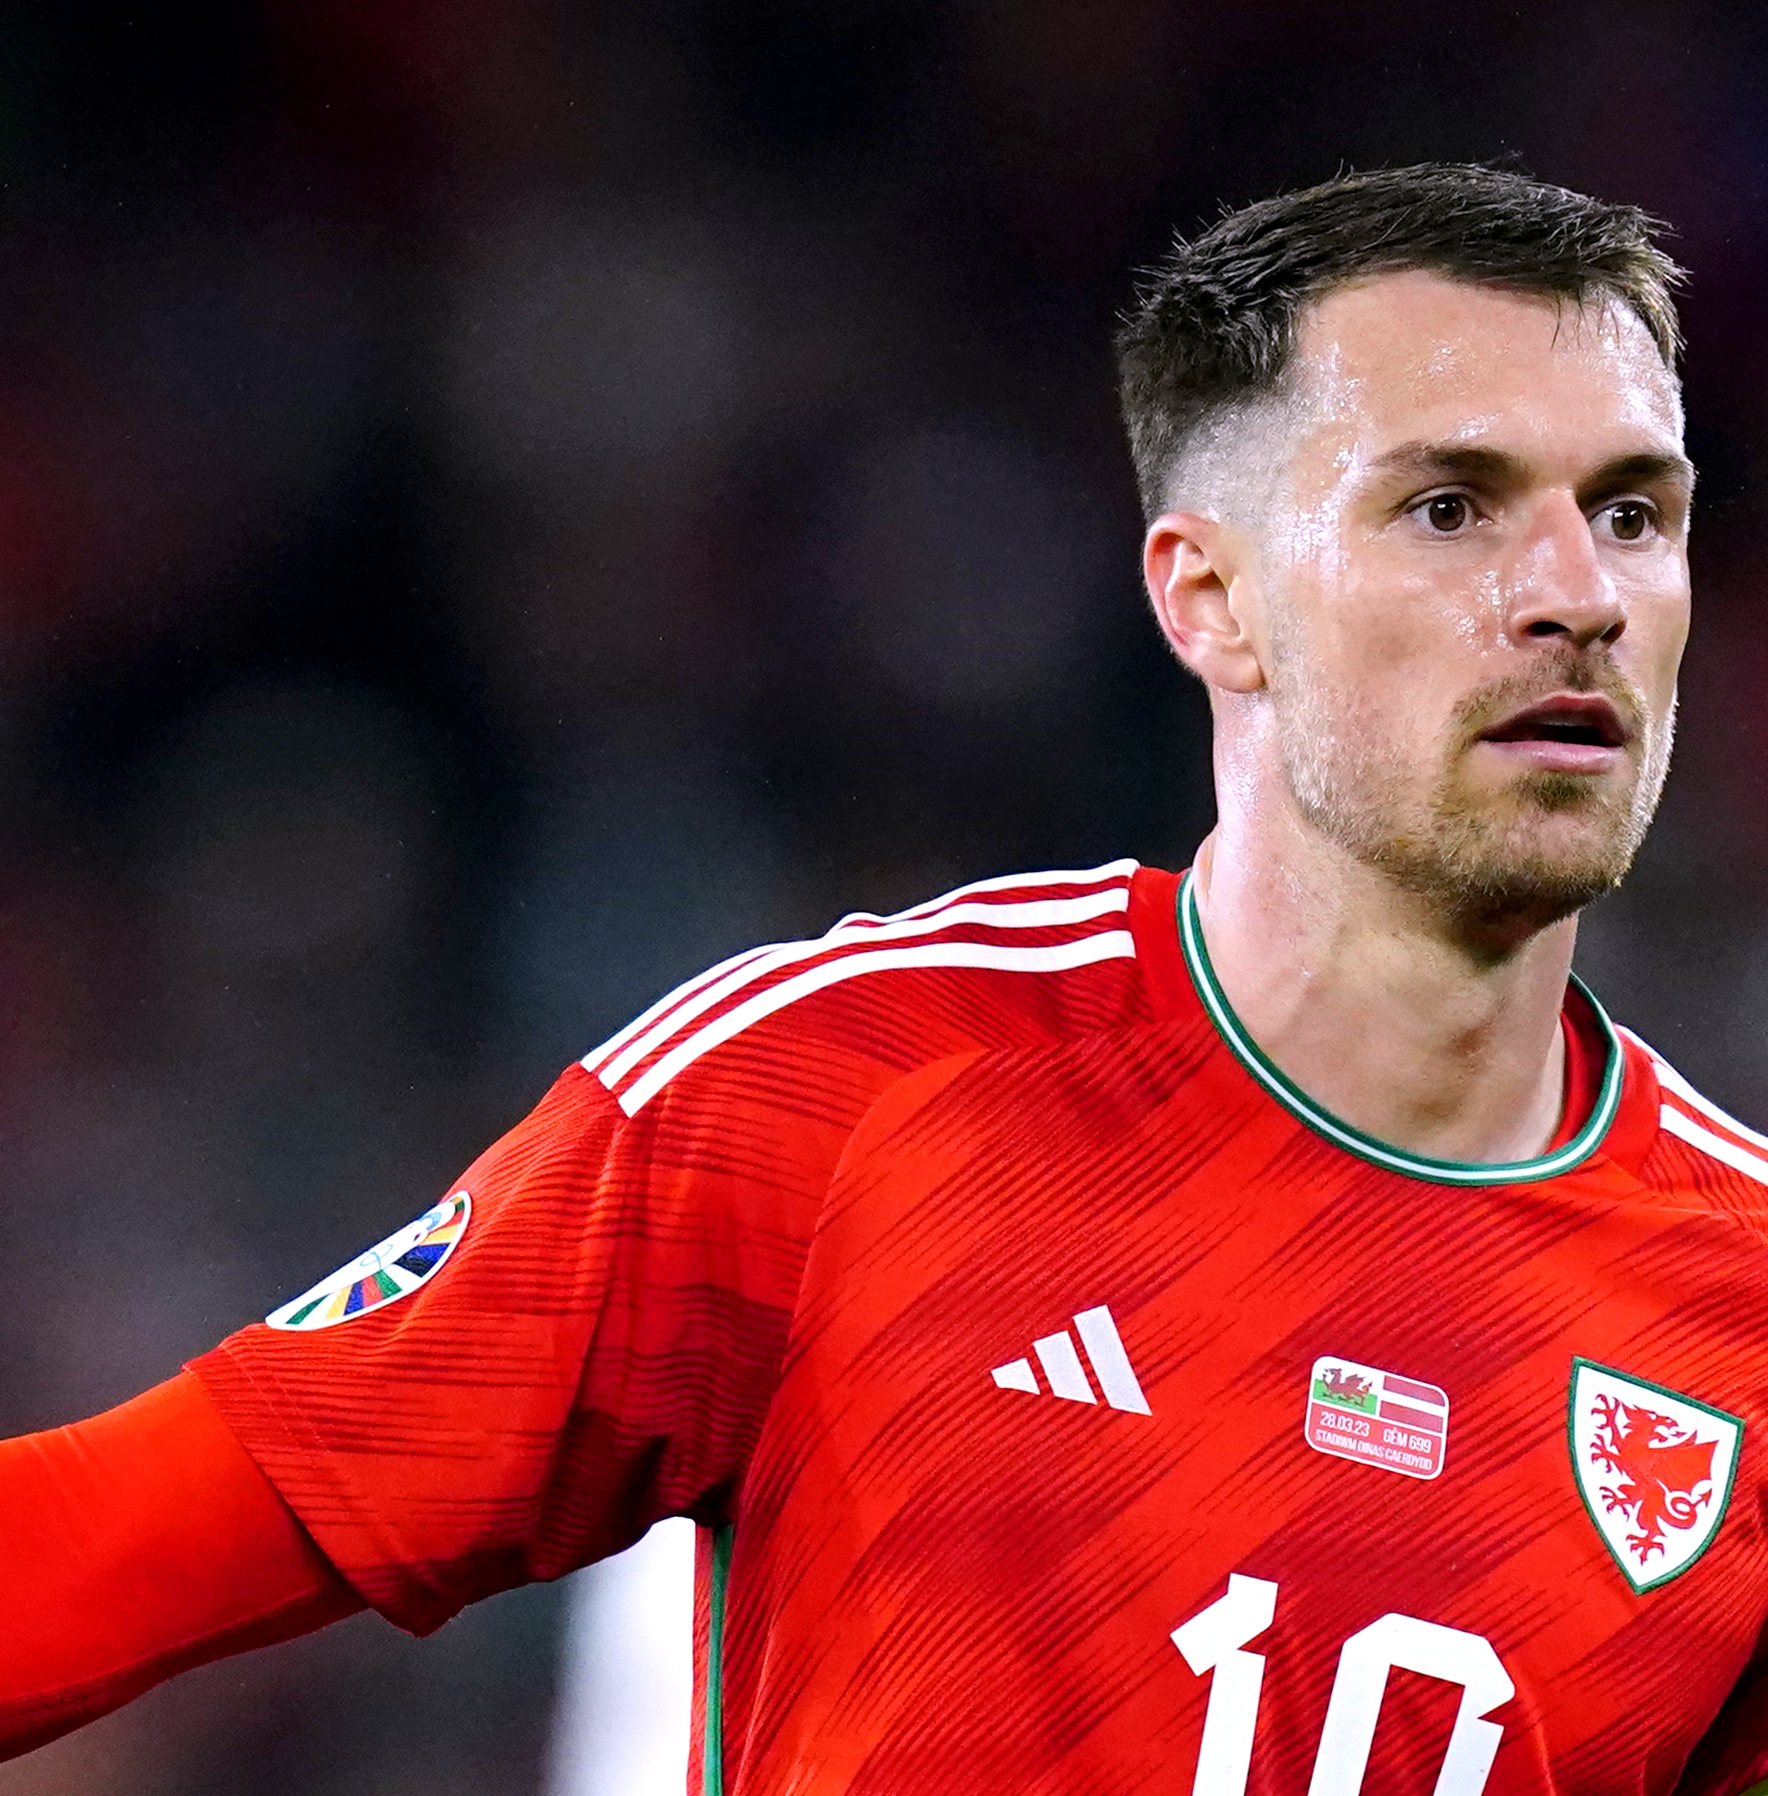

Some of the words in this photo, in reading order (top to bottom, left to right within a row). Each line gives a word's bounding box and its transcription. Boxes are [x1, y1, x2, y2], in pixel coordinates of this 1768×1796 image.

[1315, 1429, 1357, 1451] STADIWM
[1358, 1440, 1385, 1458] DINAS
[1385, 1449, 1432, 1470] CAERDYDD
[1320, 1411, 1370, 1437] 28.03.23
[1409, 1435, 1432, 1453] 699
